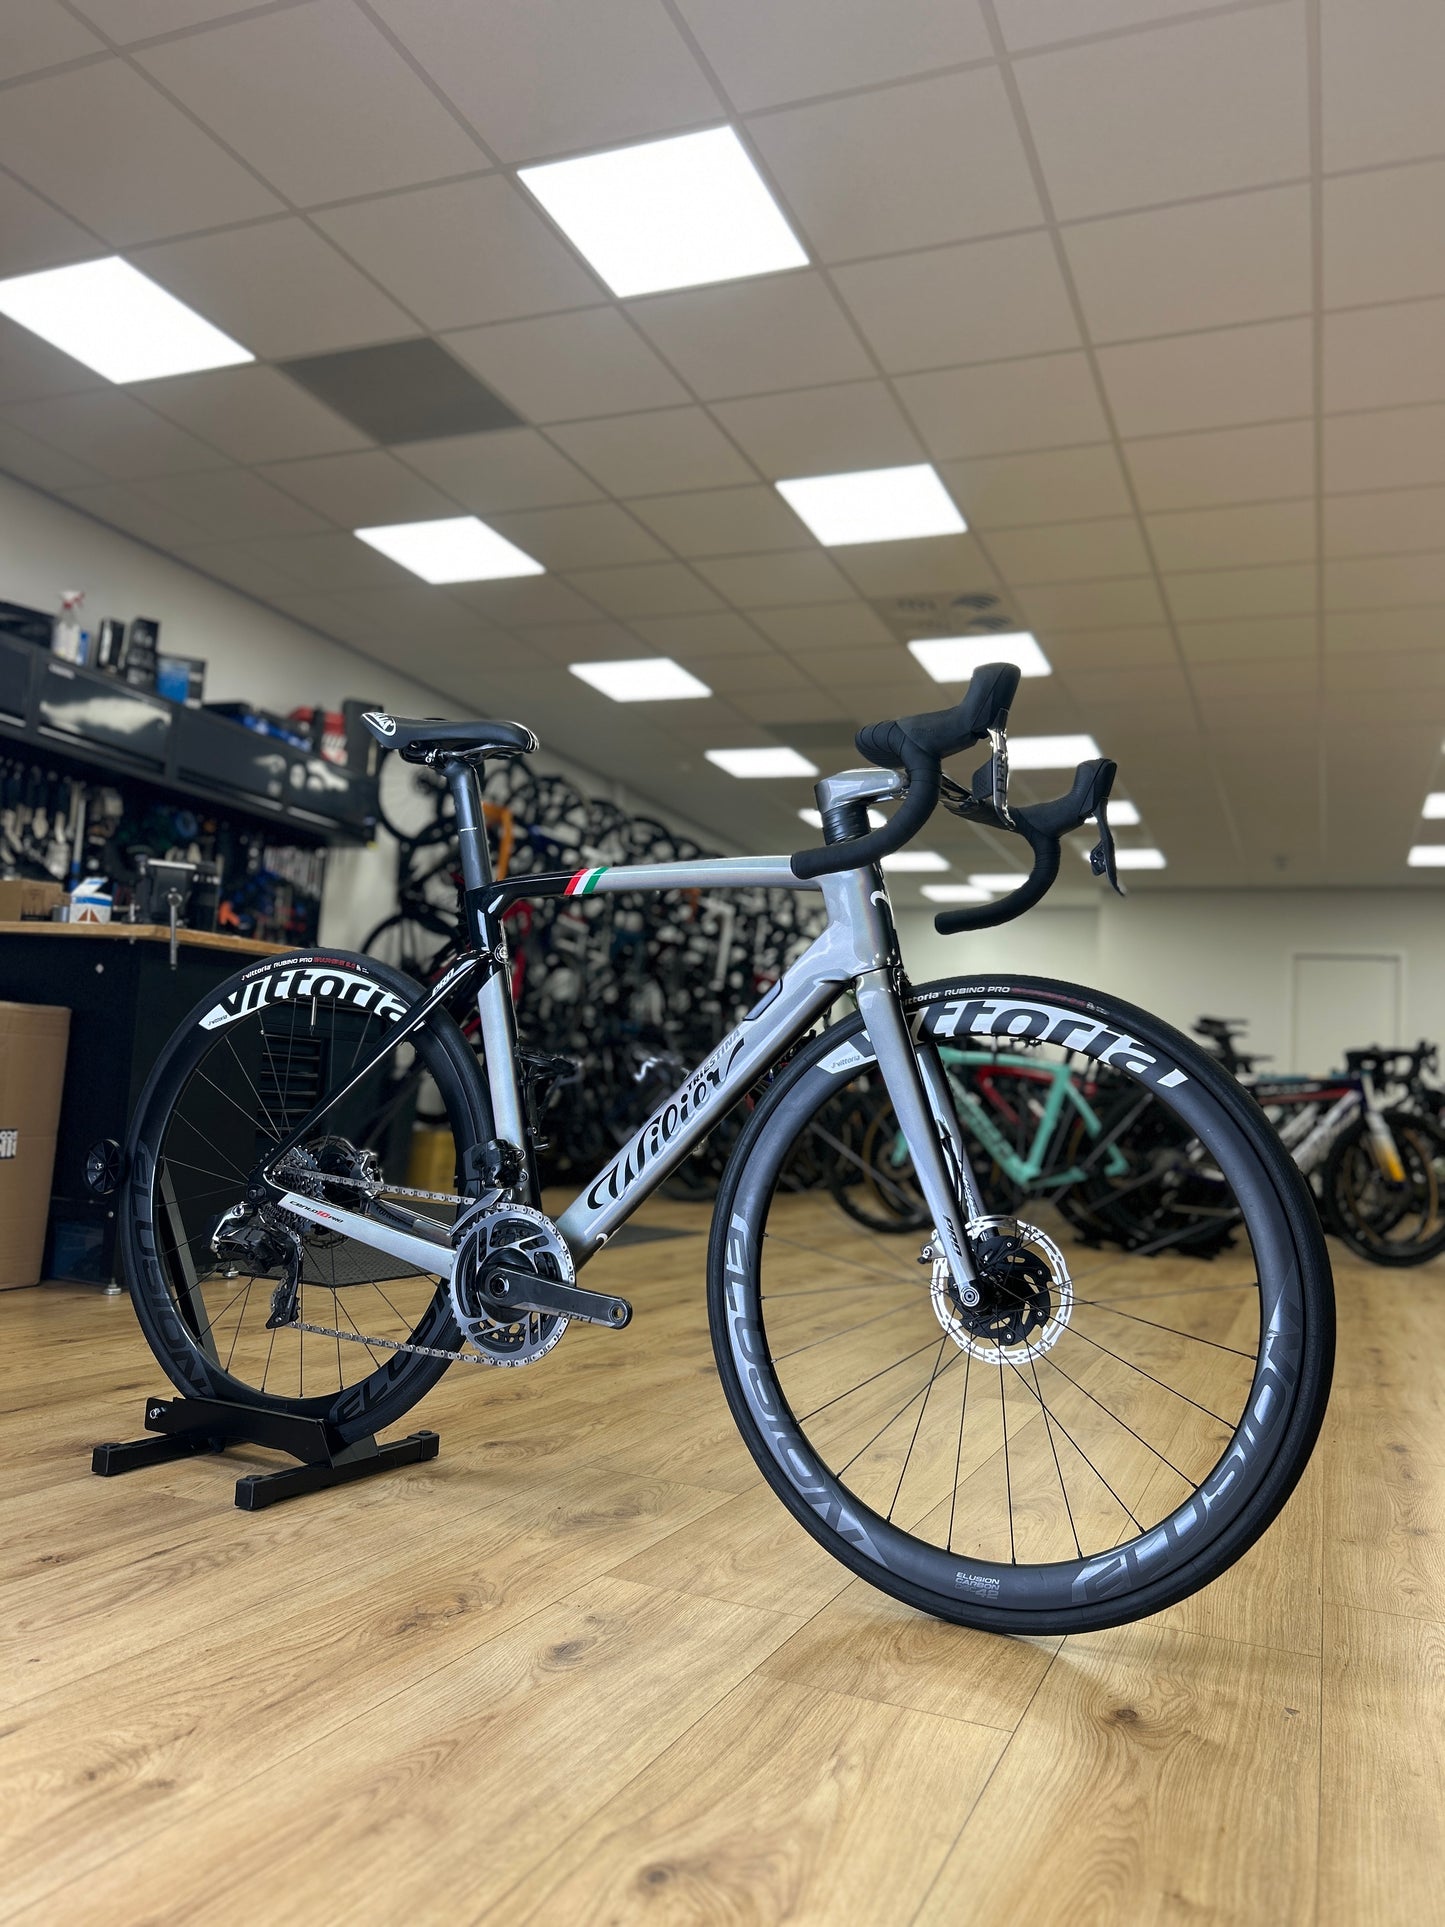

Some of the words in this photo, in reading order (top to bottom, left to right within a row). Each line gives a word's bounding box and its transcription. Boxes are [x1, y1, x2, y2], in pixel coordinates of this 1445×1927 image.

[274, 958, 298, 968] RUBINO
[220, 969, 412, 1027] vittoria
[902, 992, 940, 1006] ittoria
[944, 986, 985, 997] RUBINO
[987, 986, 1010, 994] PRO
[686, 1028, 741, 1091] TRIESTINA
[834, 1055, 861, 1066] vittoria
[726, 1222, 880, 1557] ELUSION
[955, 1578, 1000, 1590] CARBON
[956, 1572, 1000, 1585] ELUSION
